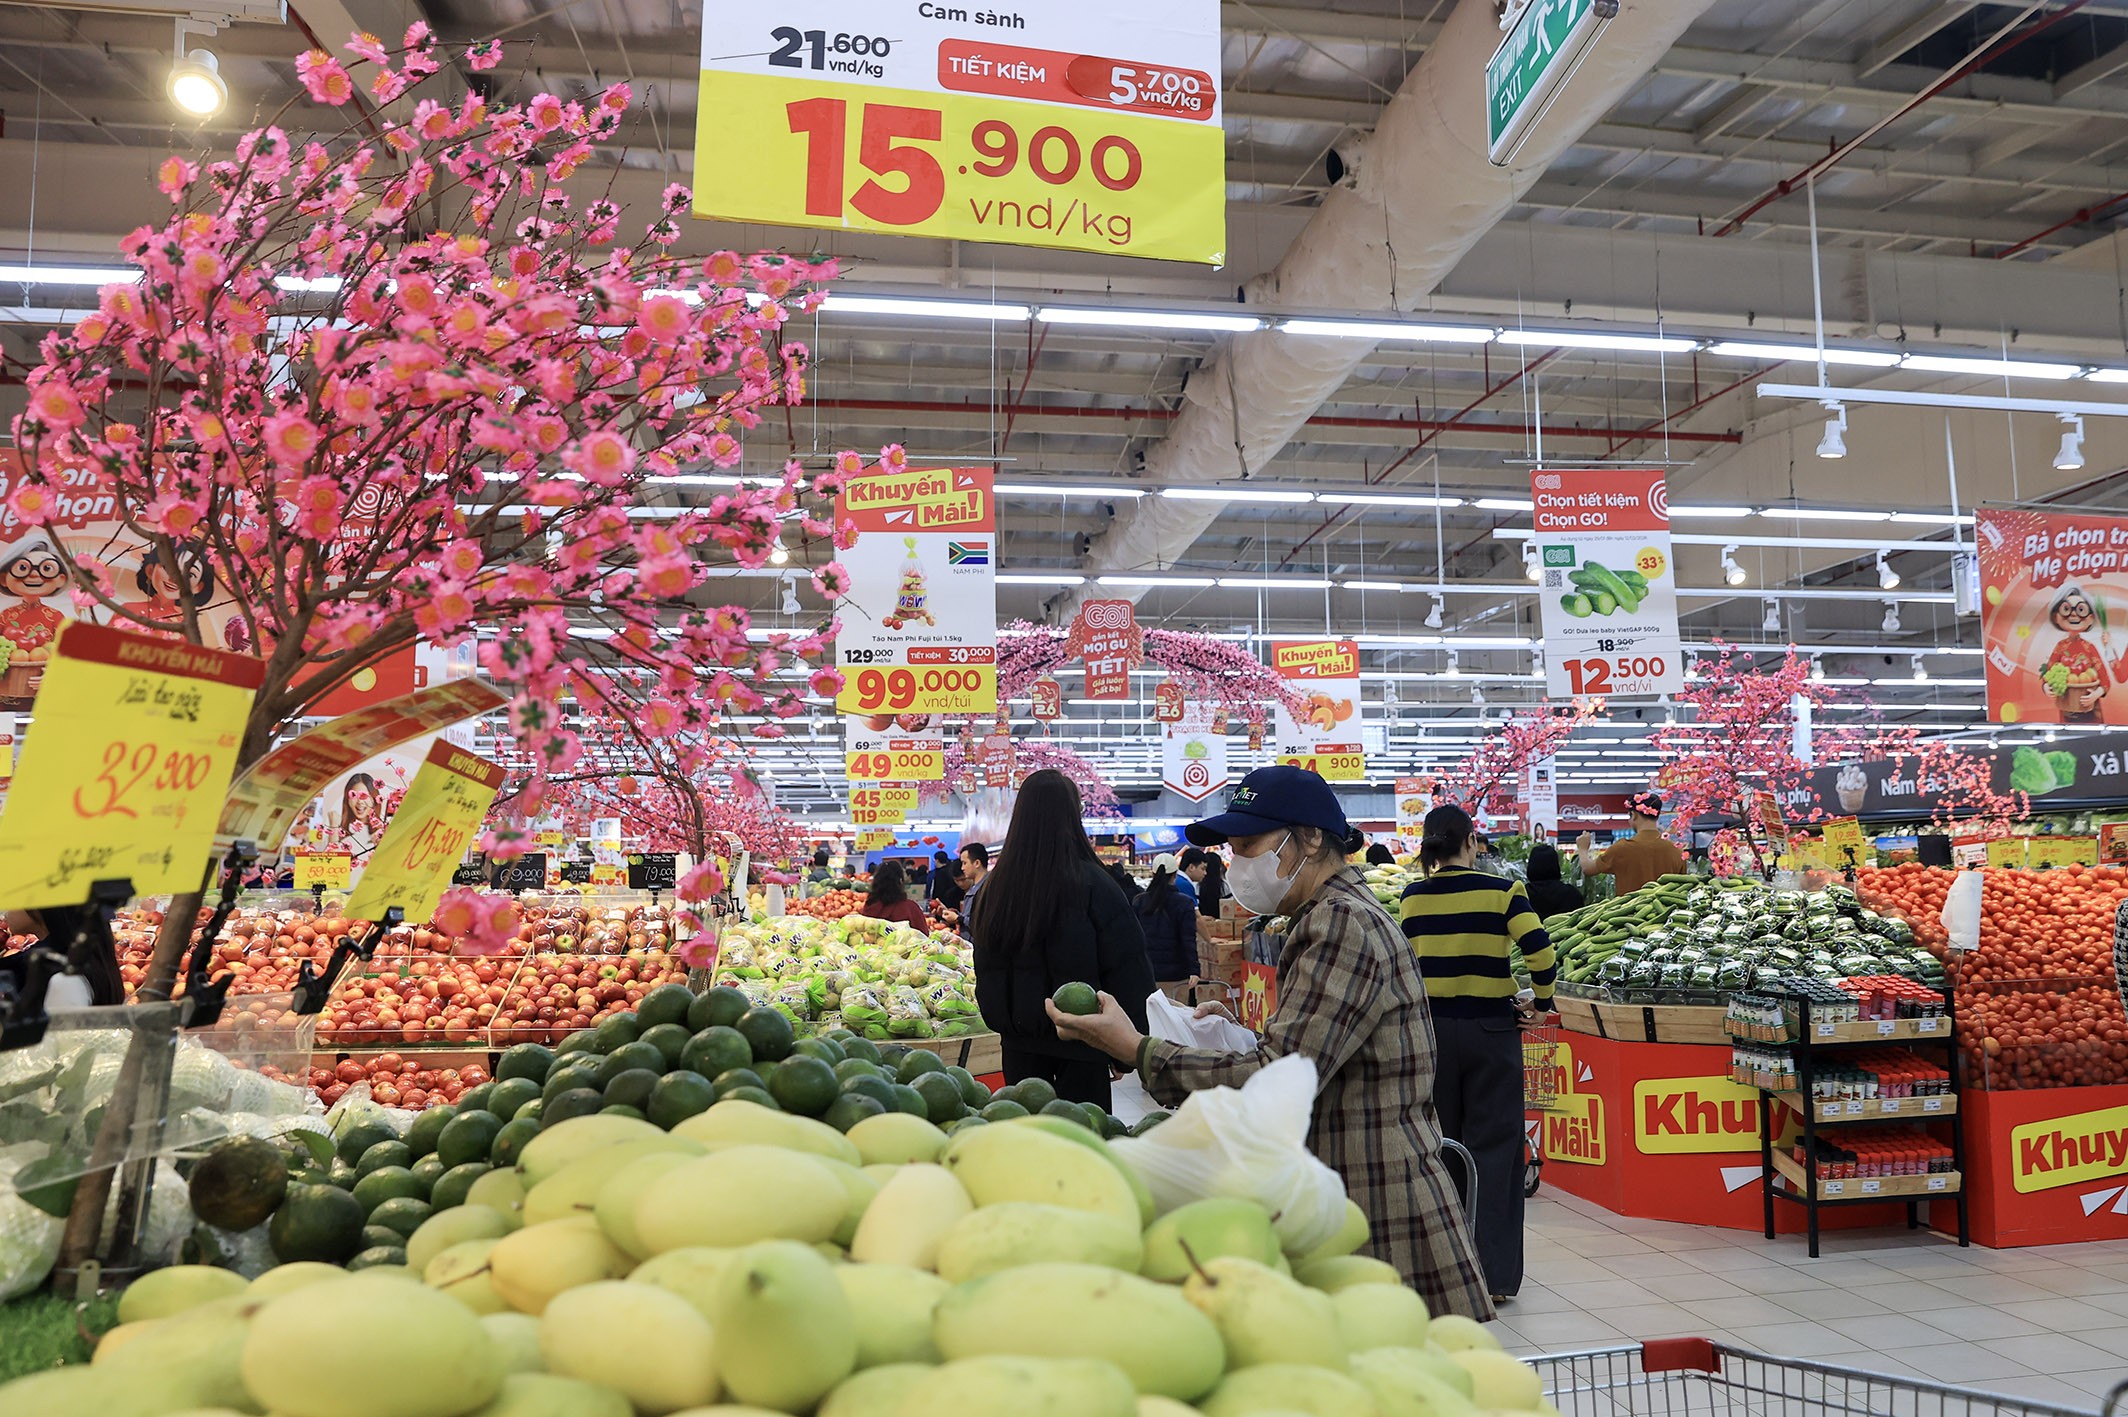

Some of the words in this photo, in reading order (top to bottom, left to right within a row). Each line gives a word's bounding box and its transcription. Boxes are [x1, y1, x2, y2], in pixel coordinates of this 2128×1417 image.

[918, 2, 968, 24] Cam
[974, 8, 1026, 30] sành
[769, 26, 890, 70] 21.600
[829, 59, 884, 79] vnd/kg
[948, 54, 993, 78] TIẾT
[996, 62, 1046, 84] KIỆM
[1109, 66, 1200, 104] 5.700
[1500, 64, 1523, 121] EXIT
[785, 97, 1142, 226] 15.900
[970, 197, 1132, 246] vnd/kg
[851, 475, 946, 503] Khuyến
[1537, 493, 1575, 509] Chọn
[1578, 491, 1602, 506] tiết
[1604, 493, 1639, 509] kiệm
[54, 493, 115, 523] họn
[924, 491, 978, 523] Mãi!
[1539, 512, 1577, 529] Chọn
[1580, 512, 1608, 526] GO!
[2023, 530, 2050, 559] Bà
[2054, 526, 2105, 549] chọn
[2110, 526, 2128, 545] tr
[1636, 556, 1664, 569] -33%
[2032, 557, 2062, 583] Mẹ
[2066, 550, 2118, 574] chọn
[1085, 604, 1130, 629] GO!
[918, 635, 932, 643] Fuji
[944, 635, 962, 643] 1.5kg
[1084, 643, 1107, 655] MỌI
[1110, 639, 1128, 651] GU
[117, 641, 190, 671] KHUYẾN
[845, 649, 893, 663] 129.000
[948, 648, 991, 663] 30.000
[1088, 652, 1125, 676] TẾT
[1281, 645, 1334, 663] Khuyến
[1321, 655, 1350, 674] Mãi!
[1562, 657, 1665, 695] 12.500
[857, 669, 982, 709] 99.000
[923, 693, 971, 709] vnd/túi
[912, 741, 941, 750] 20.000
[850, 754, 933, 778] 49.000
[897, 769, 928, 778] vnd/kg
[2090, 750, 2121, 776] Xà
[1918, 772, 1945, 793] ác
[853, 791, 910, 808] 45.000
[1788, 787, 1811, 807] phụ
[852, 810, 899, 823] 119.000
[500, 868, 544, 882] 69.000
[1550, 1098, 1600, 1159] Mãi!
[2020, 1127, 2128, 1176] Khuy
